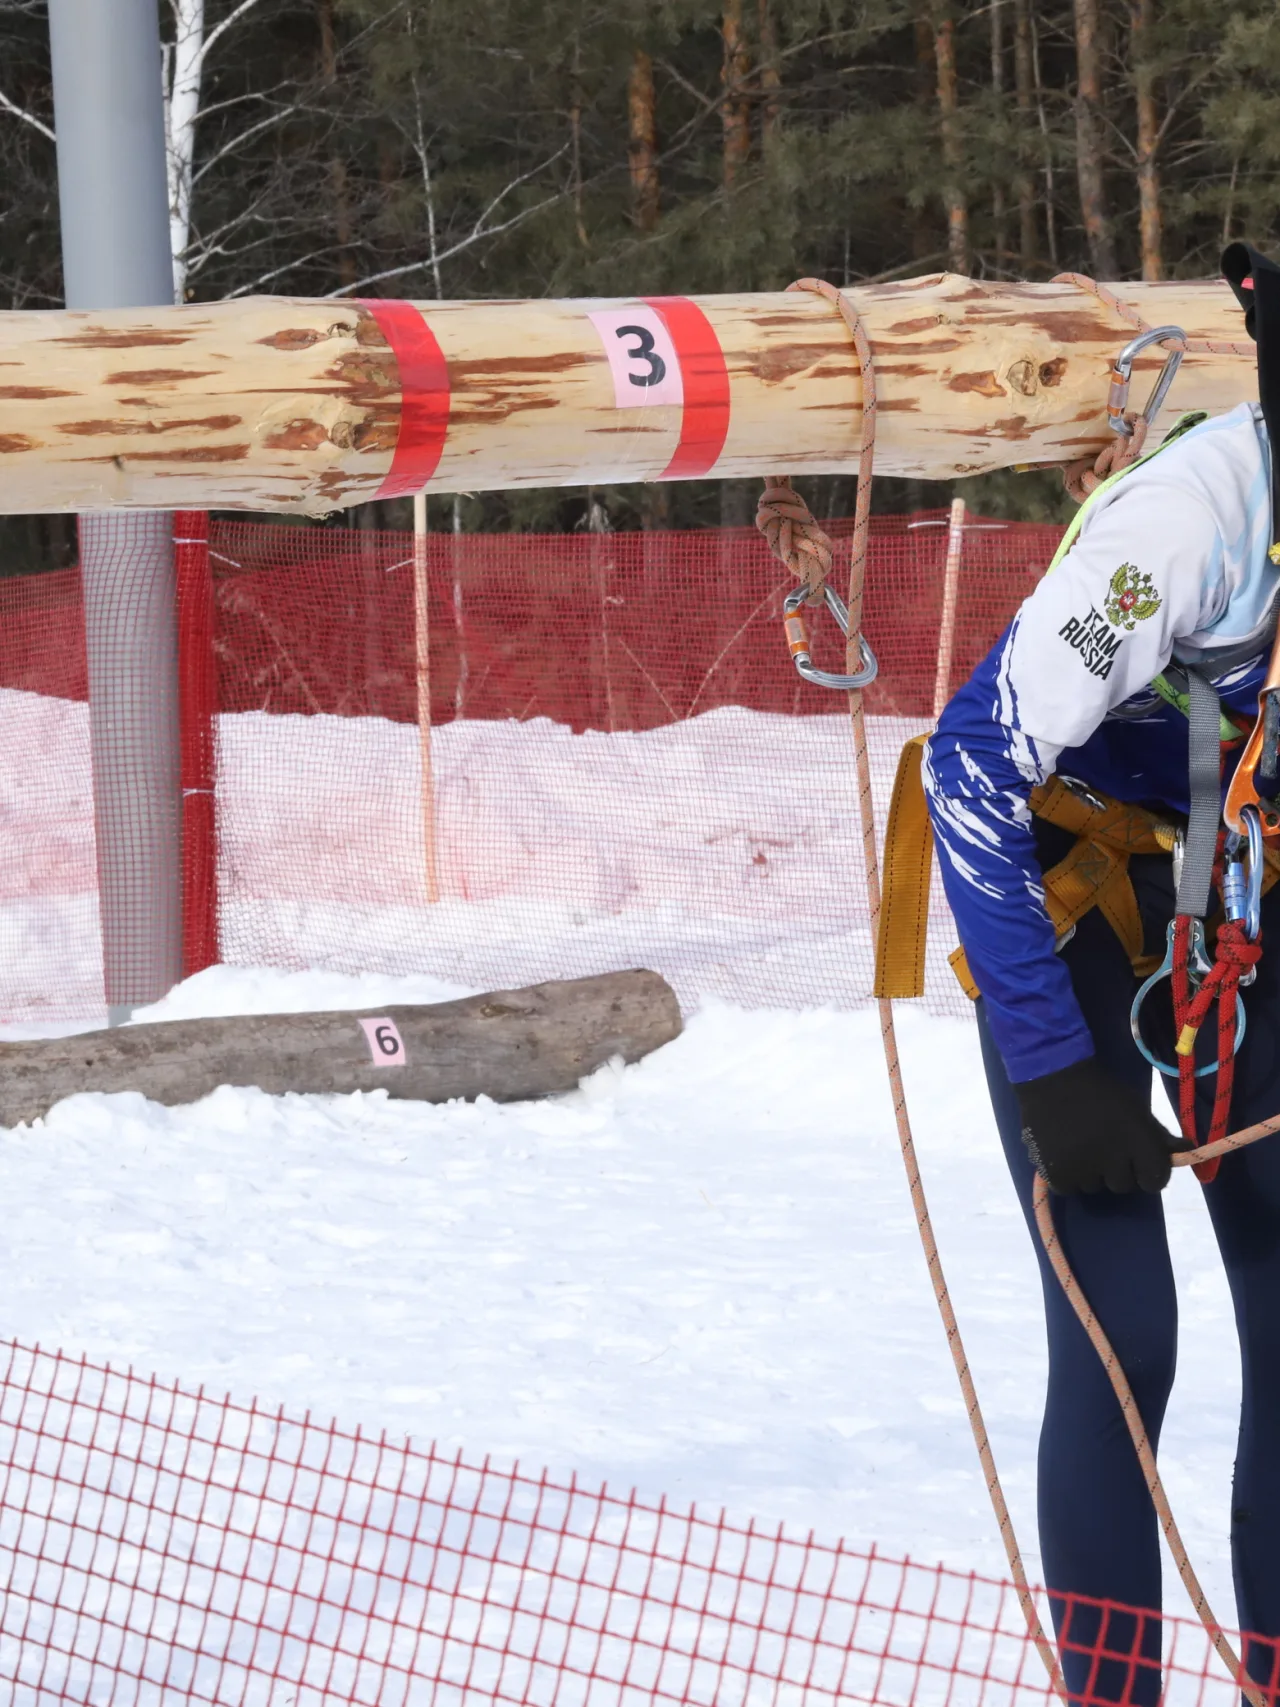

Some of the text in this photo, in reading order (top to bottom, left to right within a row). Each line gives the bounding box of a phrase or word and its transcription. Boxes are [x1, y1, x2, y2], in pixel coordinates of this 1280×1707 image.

[615, 325, 666, 387] 3
[1058, 615, 1115, 681] RUSSIA
[1083, 603, 1124, 659] TEAM
[375, 1025, 400, 1056] 6
